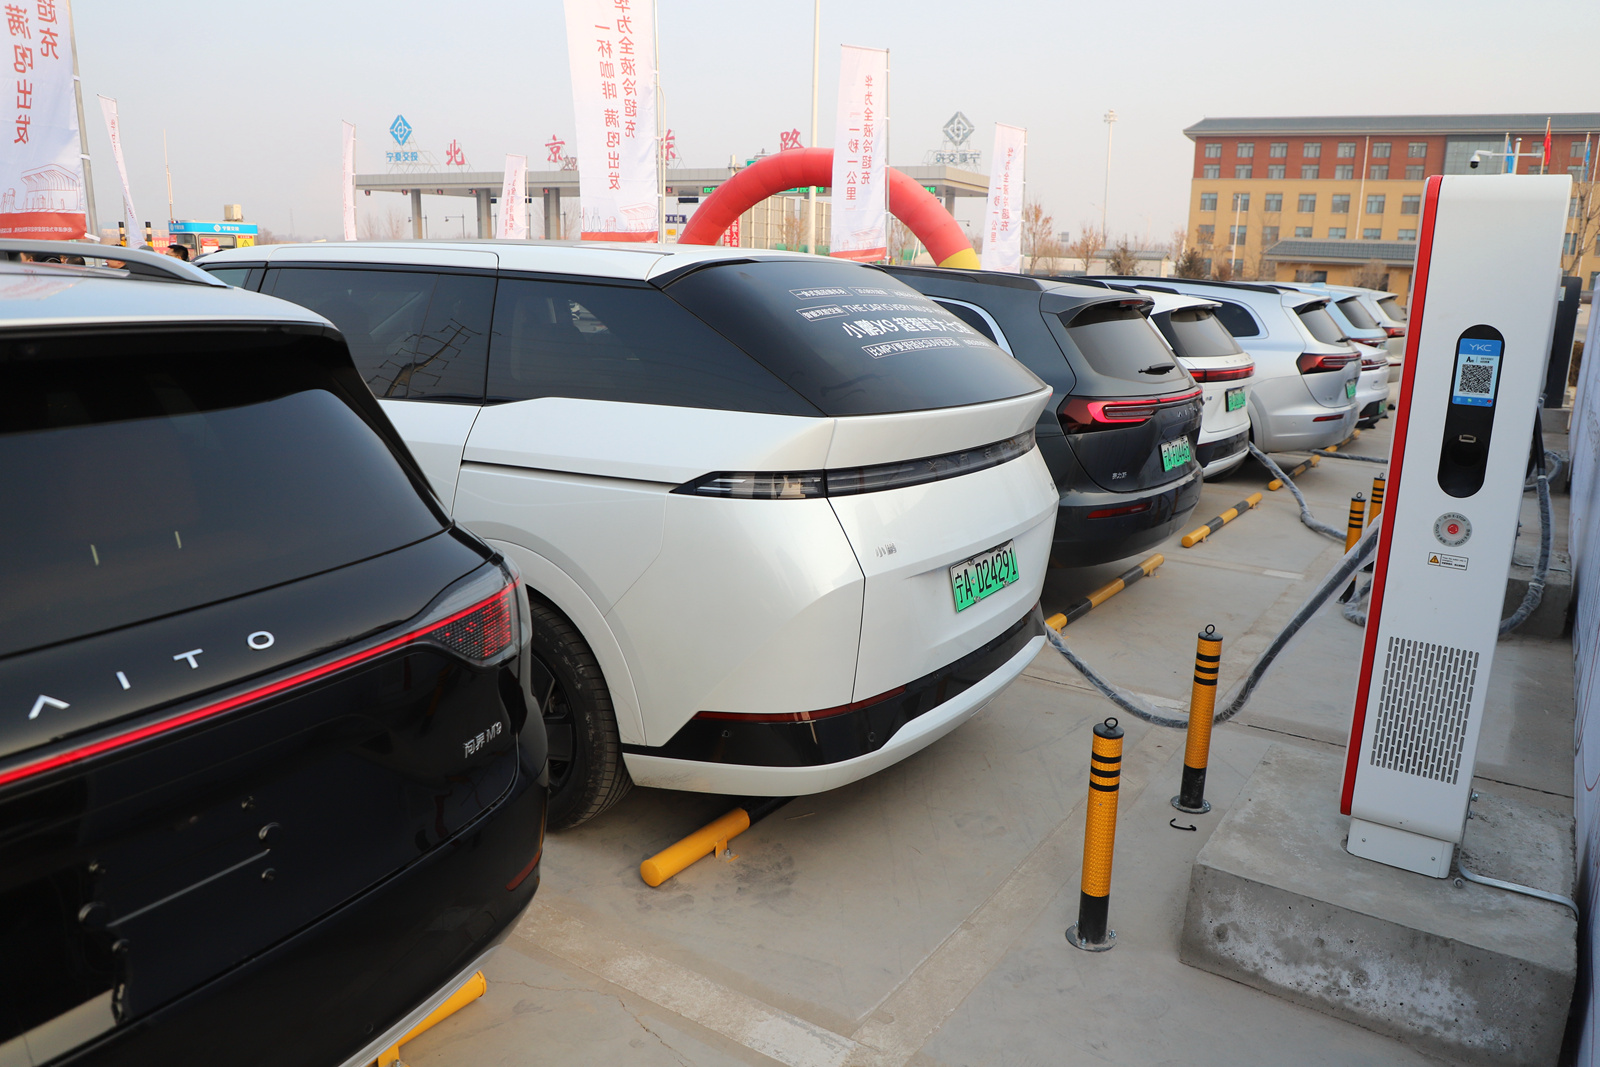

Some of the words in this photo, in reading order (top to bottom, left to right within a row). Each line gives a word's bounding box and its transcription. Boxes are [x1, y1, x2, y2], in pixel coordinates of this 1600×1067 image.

[386, 151, 418, 162] 宁夏交投
[1469, 343, 1492, 352] YKC
[27, 630, 276, 720] AITO
[463, 732, 486, 759] 问界
[486, 721, 502, 743] M9
